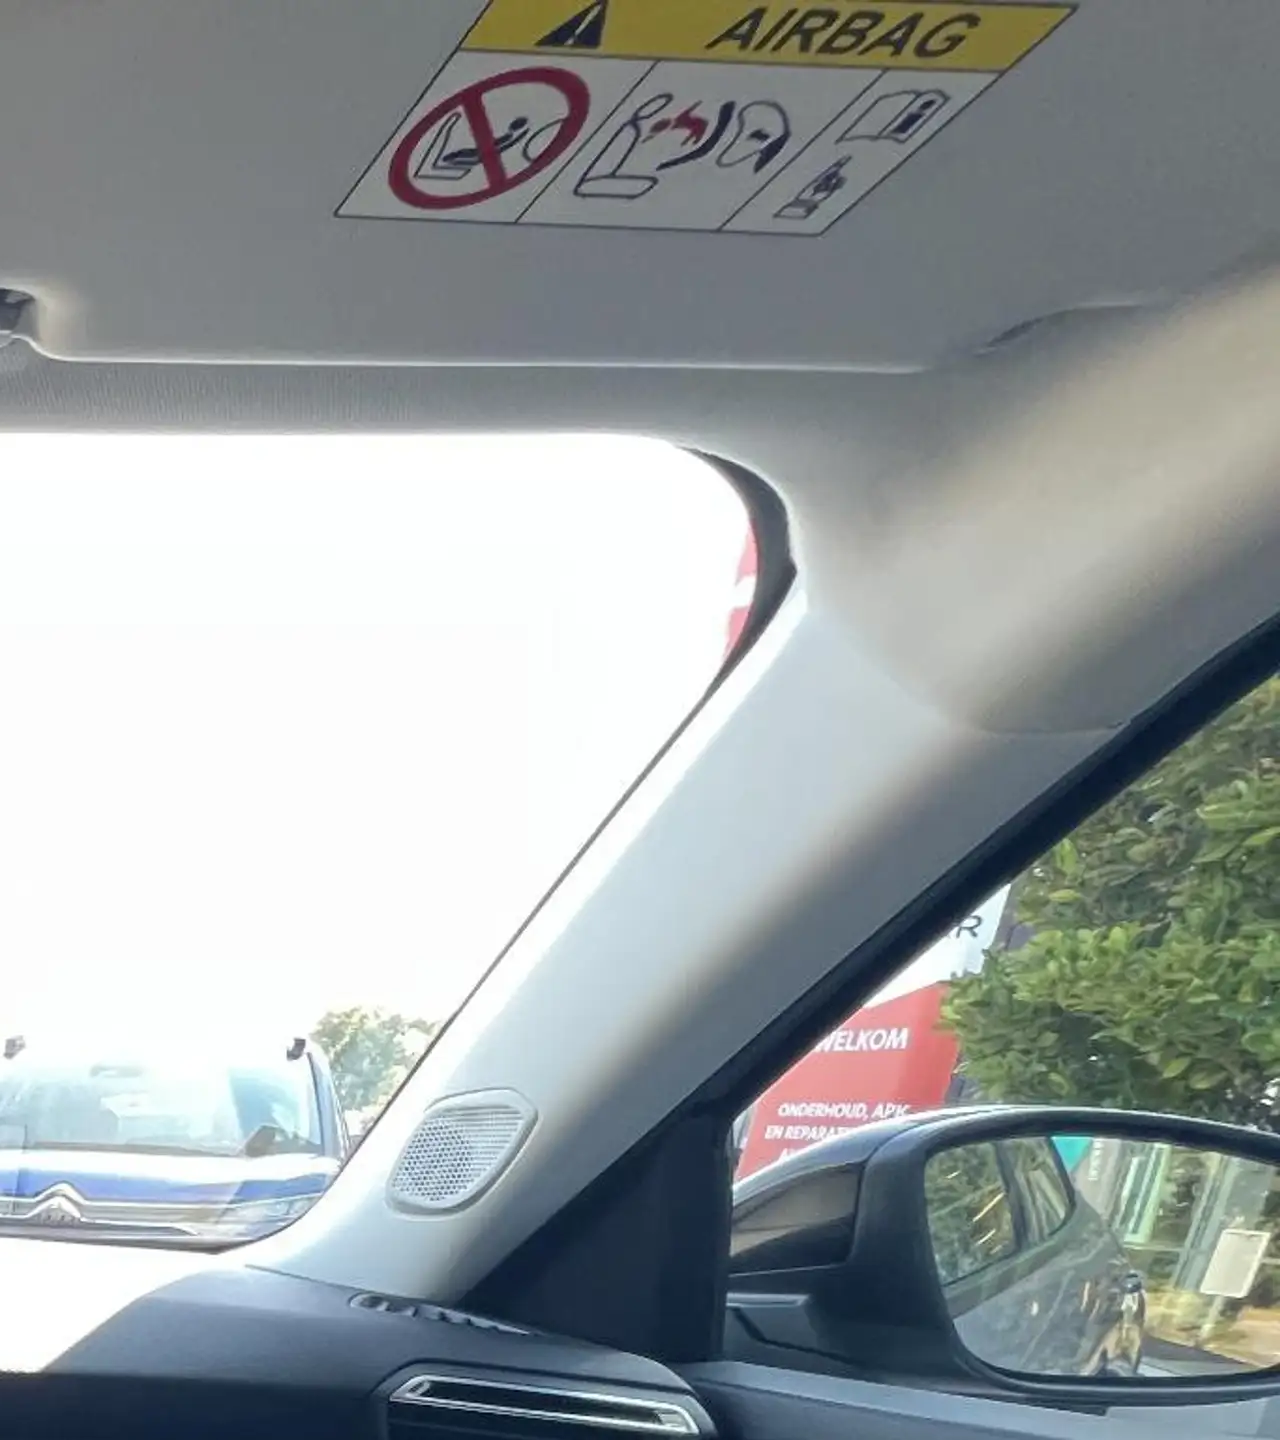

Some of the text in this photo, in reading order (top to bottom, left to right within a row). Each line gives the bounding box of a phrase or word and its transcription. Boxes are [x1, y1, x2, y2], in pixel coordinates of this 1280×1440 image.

[706, 6, 980, 60] AIRBAG
[814, 1028, 908, 1051] WELKOM
[777, 1102, 869, 1120] ONDERHOUD,
[766, 1126, 783, 1140] EN
